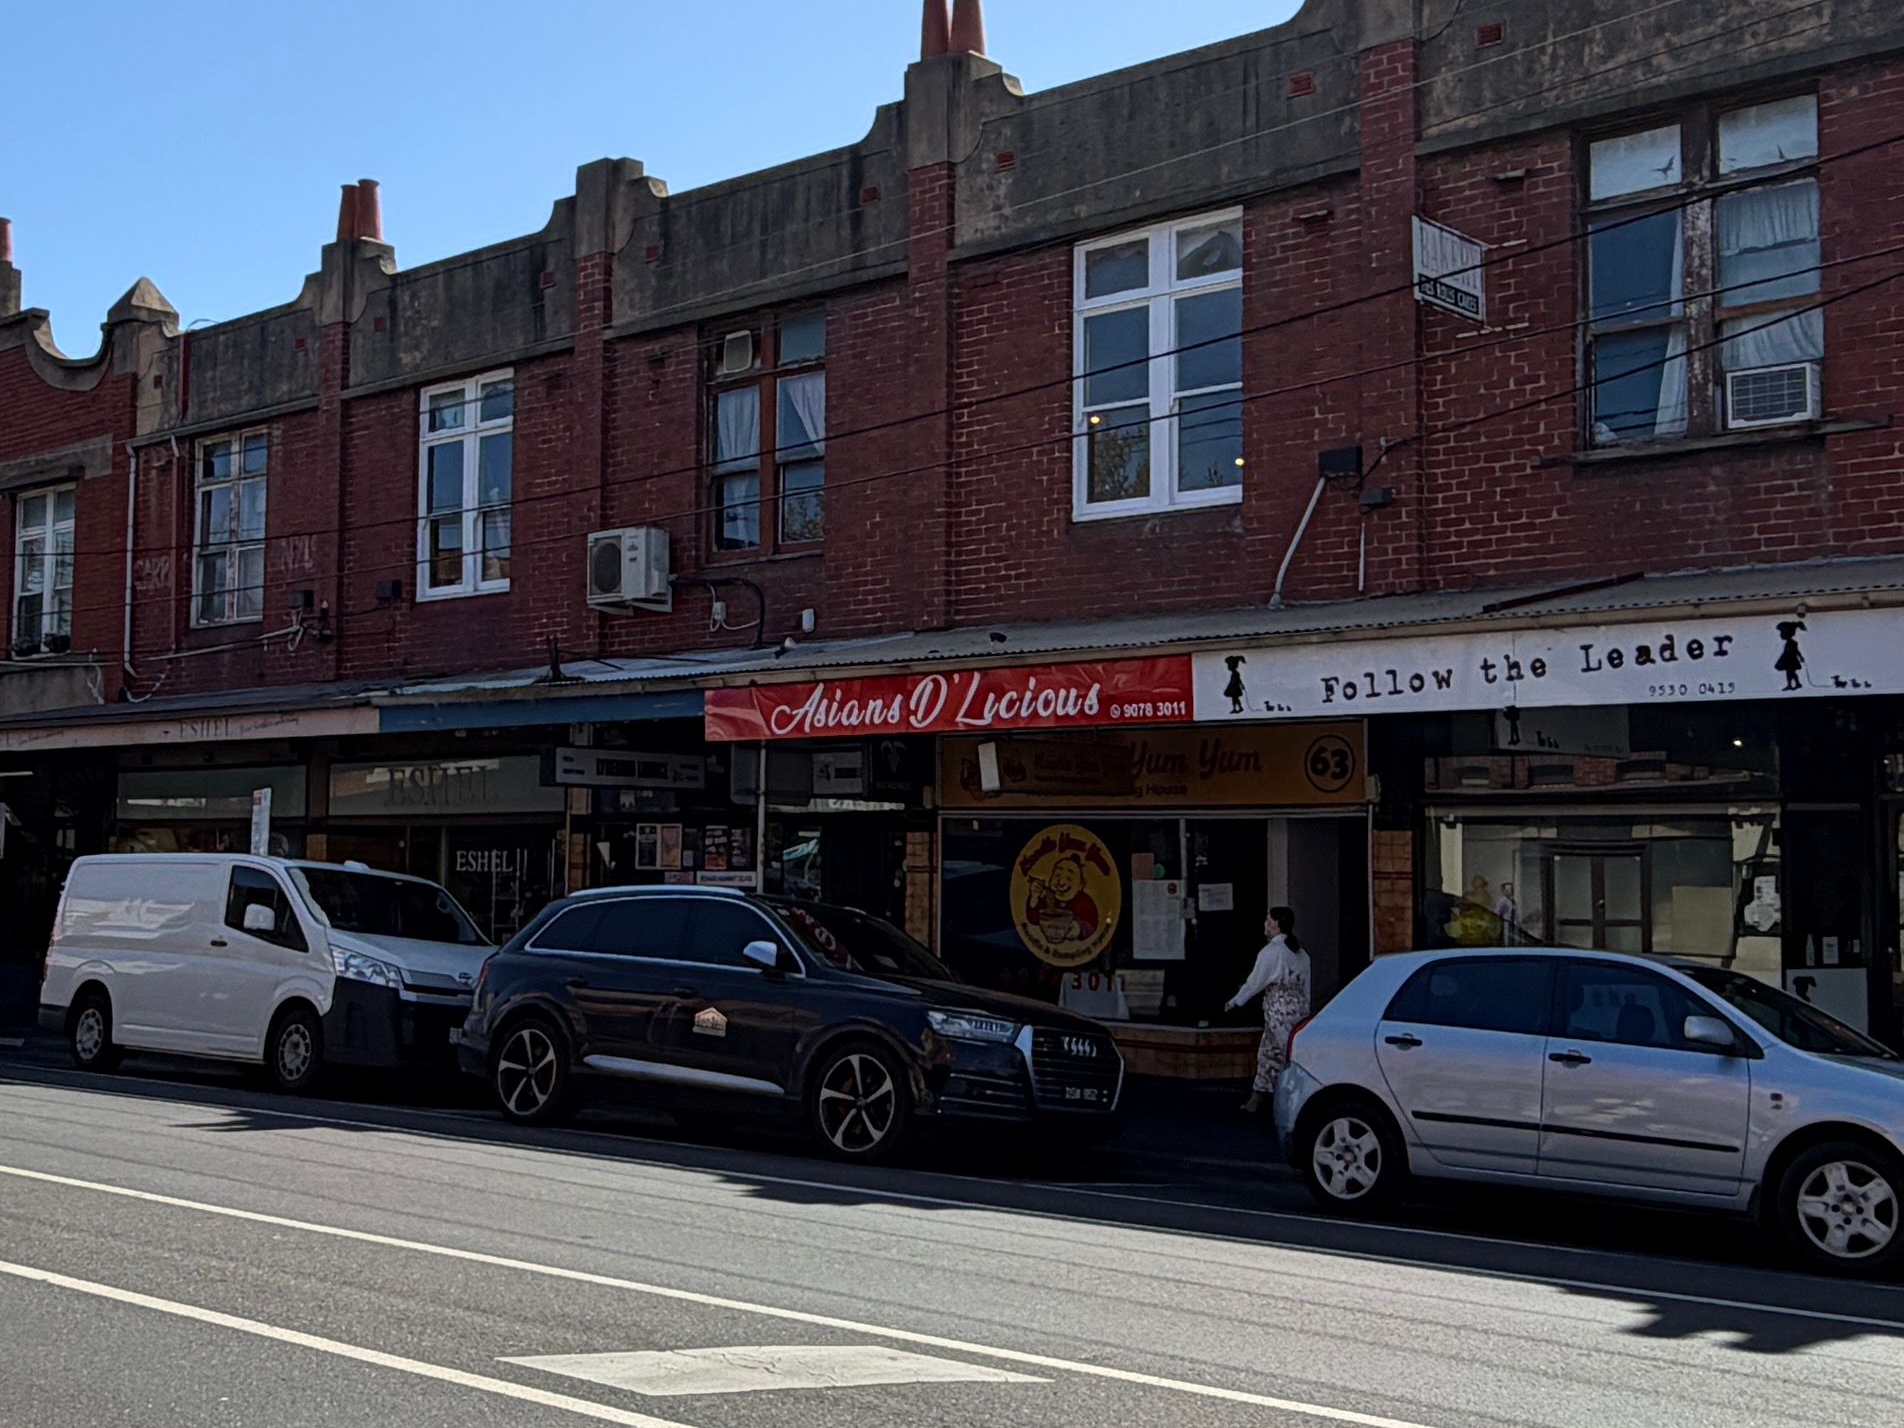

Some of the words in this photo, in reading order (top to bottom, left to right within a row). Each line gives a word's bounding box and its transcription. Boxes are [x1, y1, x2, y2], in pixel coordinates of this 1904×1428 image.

[1320, 669, 1454, 704] Follow
[1481, 654, 1548, 684] the
[1580, 634, 1734, 673] Leader
[1648, 684, 1688, 697] 9530
[771, 682, 904, 734] Asians
[1123, 702, 1154, 718] 9078
[1156, 700, 1186, 716] 3011
[180, 717, 232, 739] ESHEL
[1130, 741, 1187, 780] Yum
[1198, 738, 1262, 779] Yum
[1309, 746, 1349, 779] 63
[456, 849, 514, 872] ESHEL
